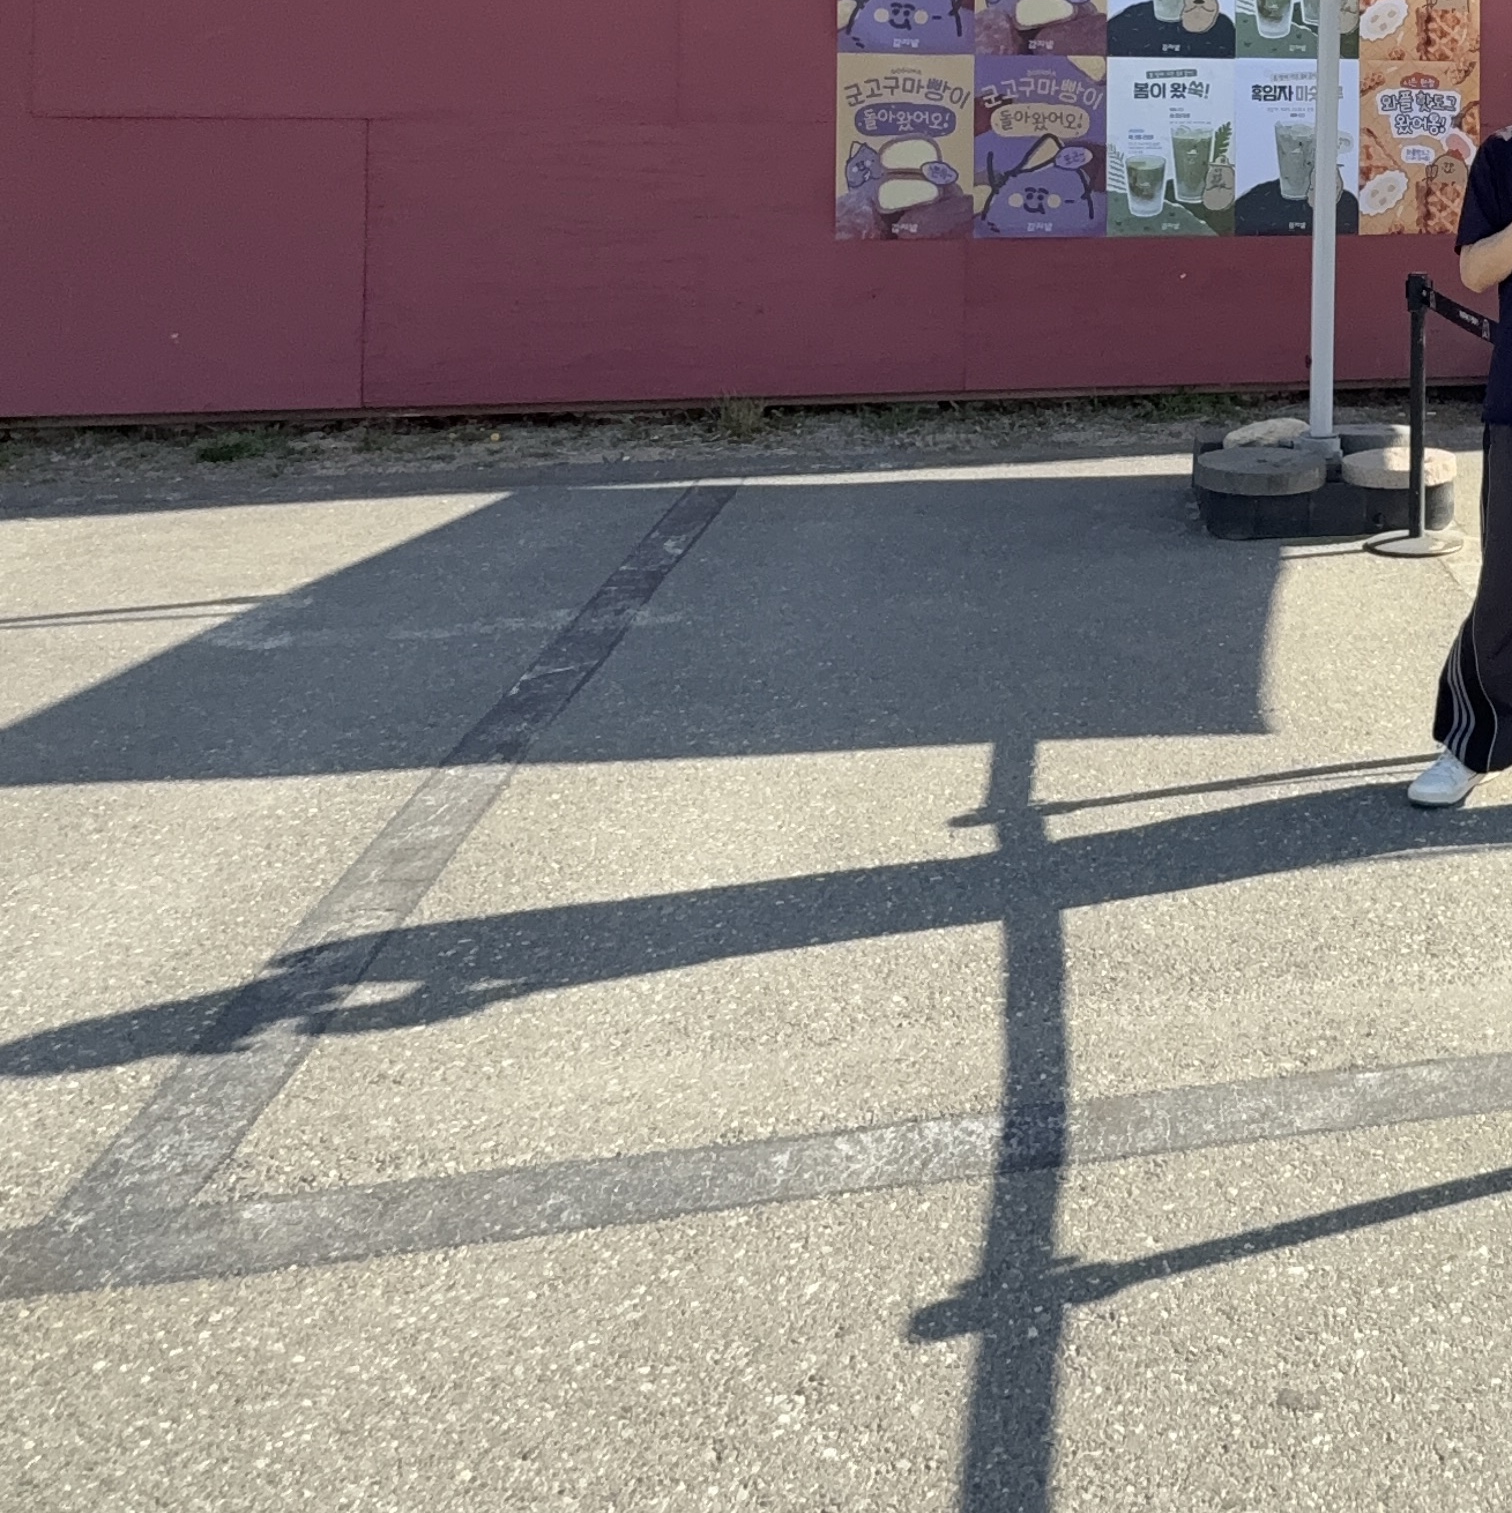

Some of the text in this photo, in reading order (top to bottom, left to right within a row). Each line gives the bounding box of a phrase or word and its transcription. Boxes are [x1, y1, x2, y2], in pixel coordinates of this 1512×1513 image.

[844, 76, 971, 109] 군고구마빵이
[981, 78, 1104, 110] 군고구마빵이
[1134, 82, 1166, 99] 봄이
[1252, 84, 1293, 101] 흑임자
[1381, 90, 1457, 113] 와플 핫도그
